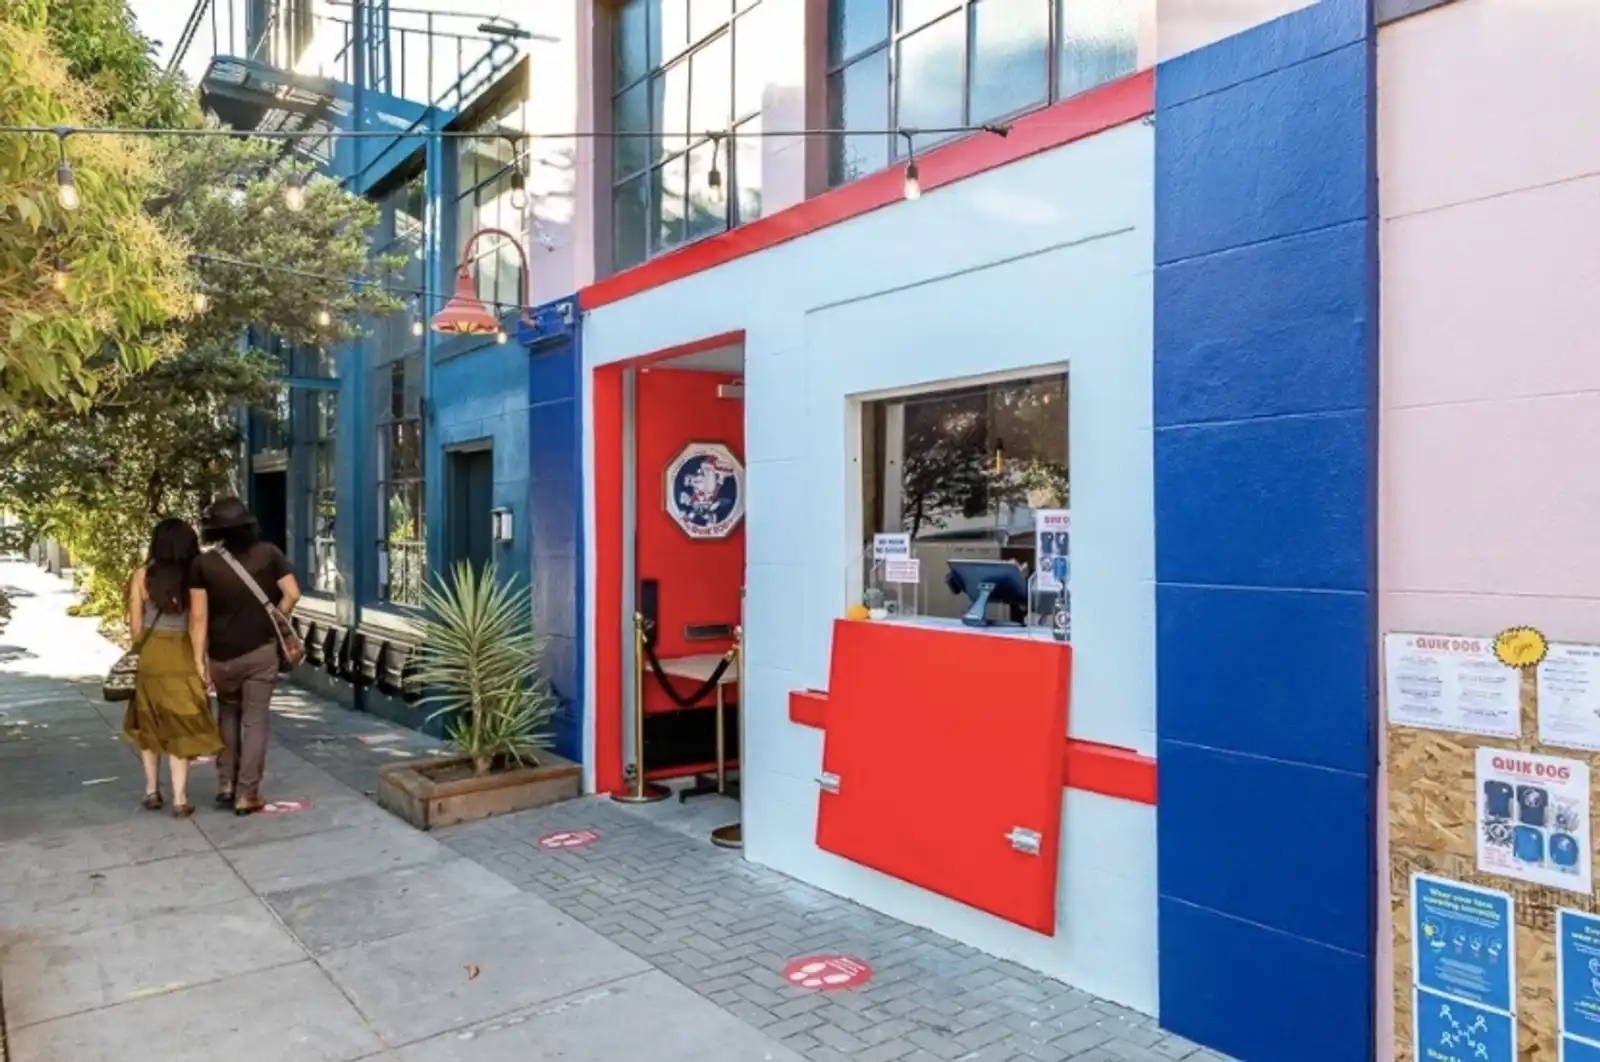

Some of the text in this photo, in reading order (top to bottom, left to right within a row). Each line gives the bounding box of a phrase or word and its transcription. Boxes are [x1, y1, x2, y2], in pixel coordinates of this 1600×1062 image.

[1416, 637, 1481, 652] QUIK DOG
[1491, 756, 1532, 774] QUIK
[1535, 763, 1570, 779] DOG
